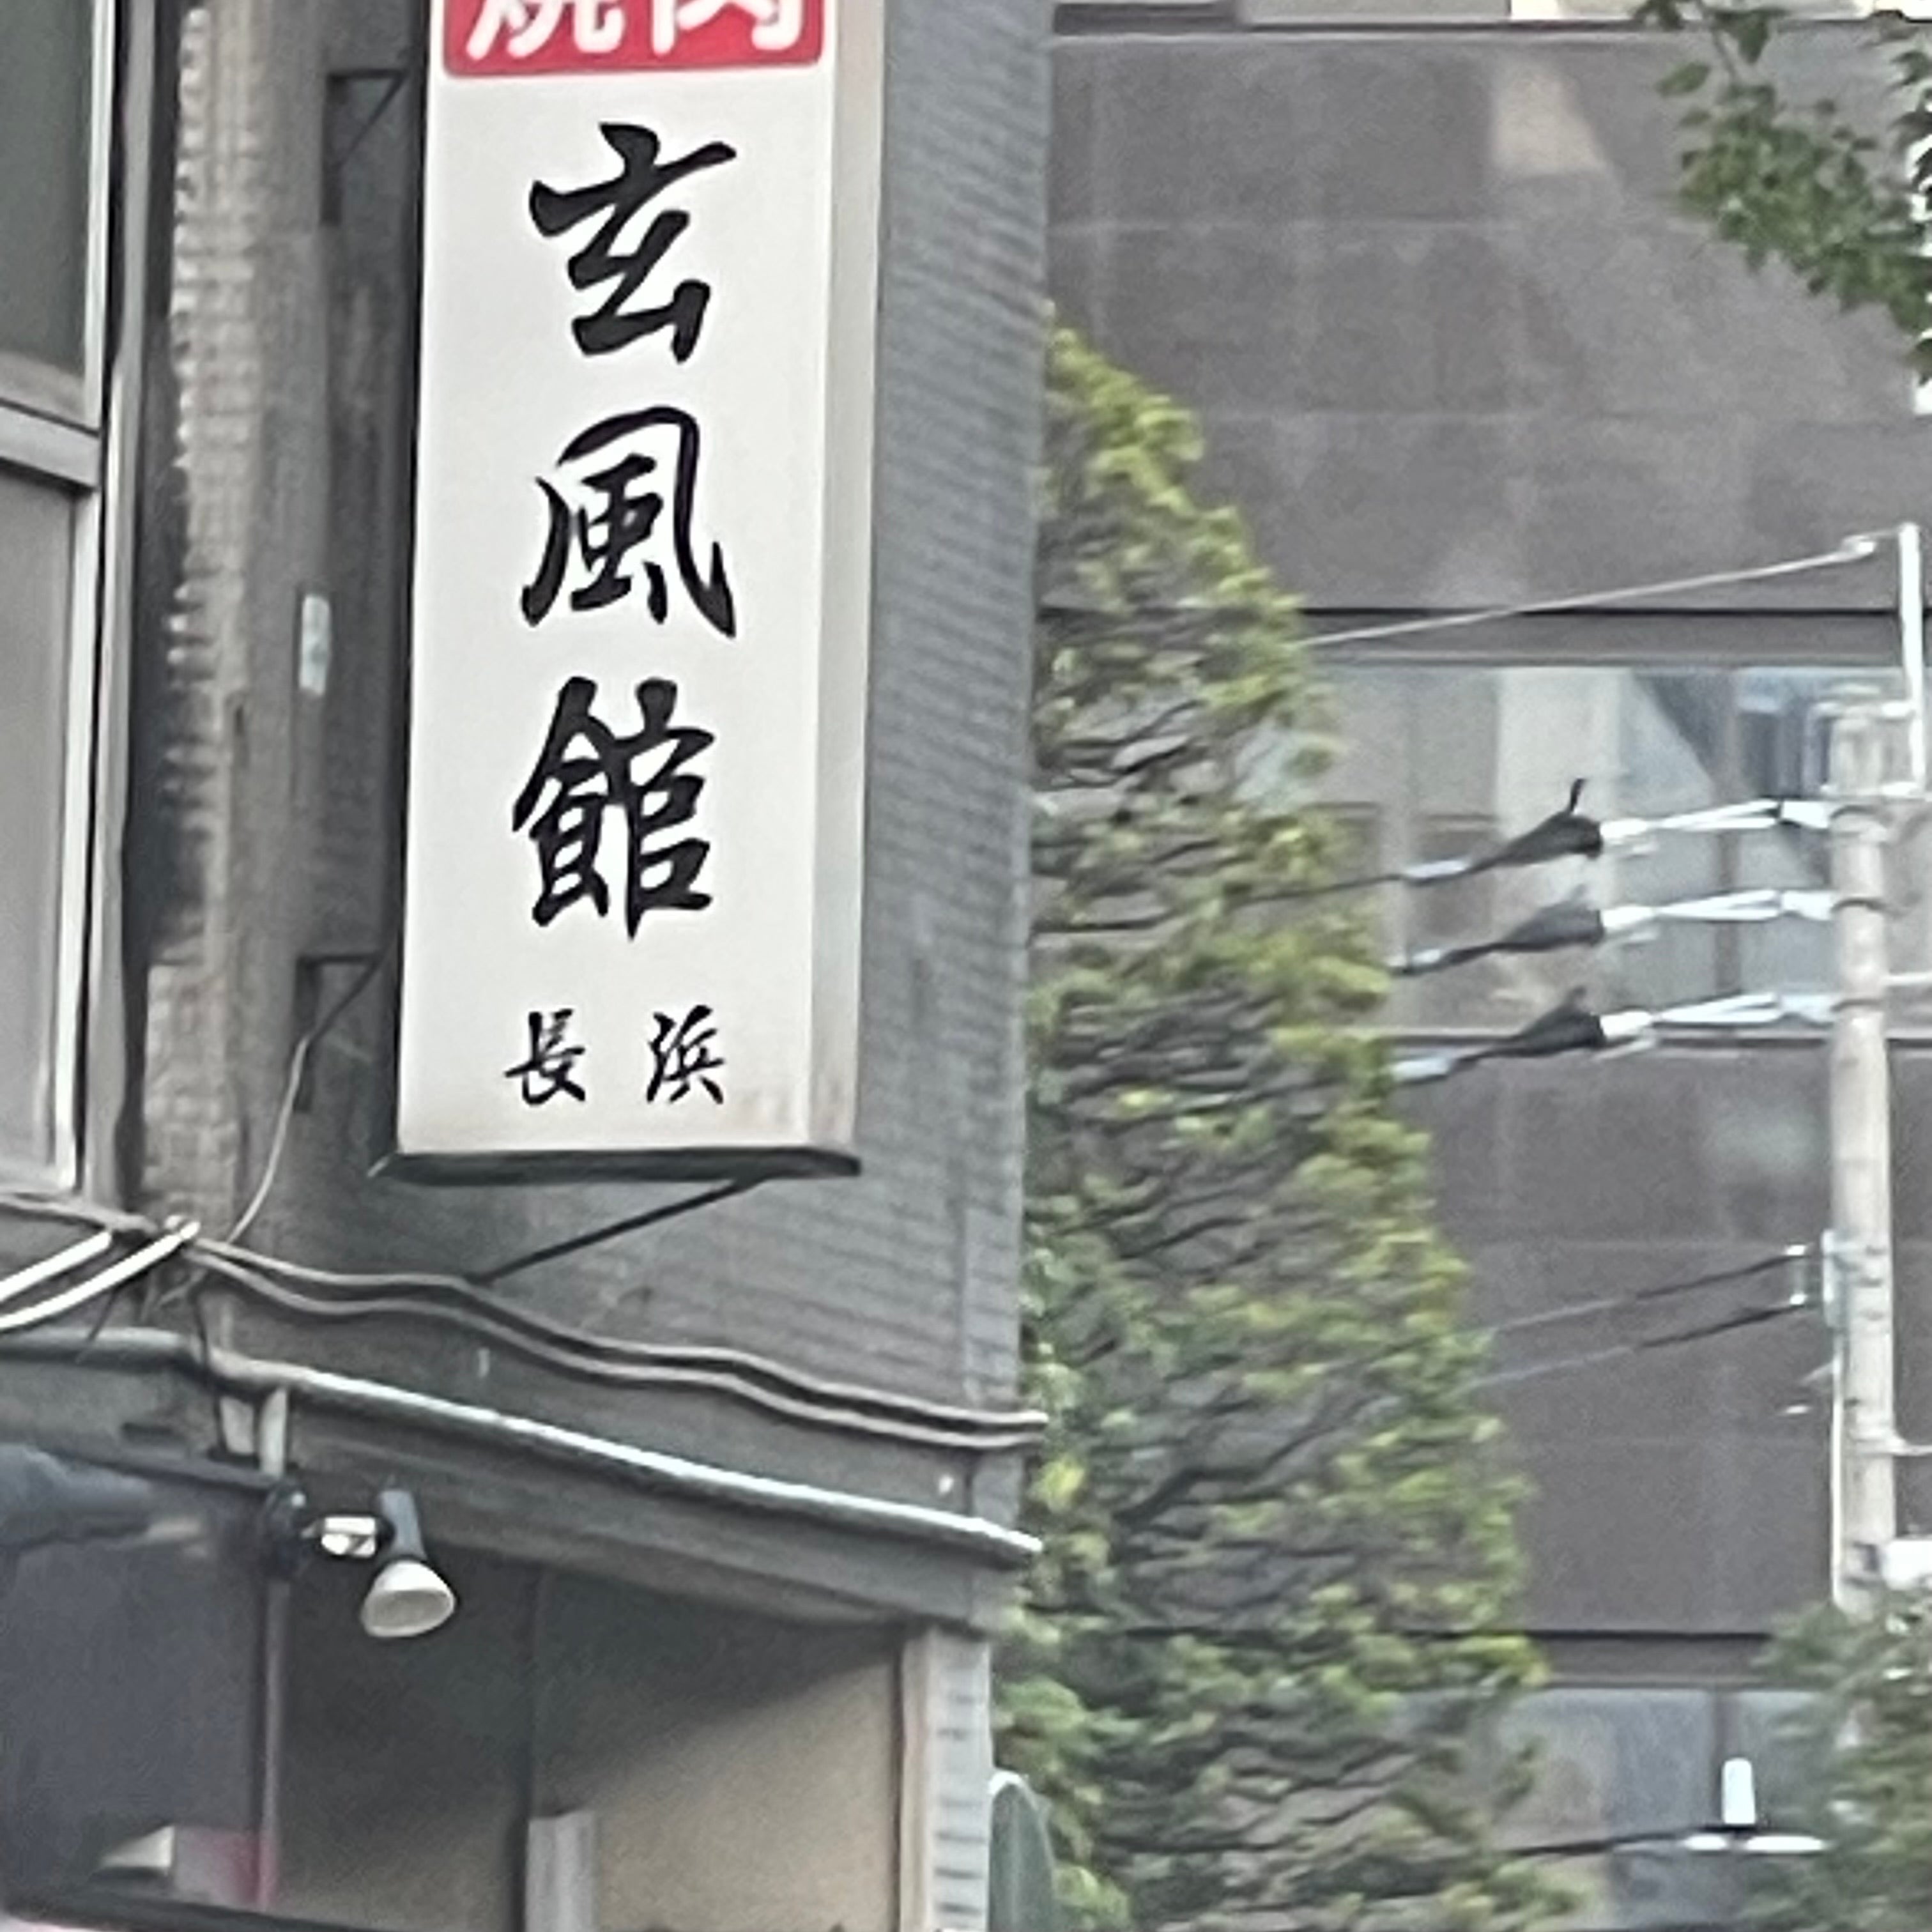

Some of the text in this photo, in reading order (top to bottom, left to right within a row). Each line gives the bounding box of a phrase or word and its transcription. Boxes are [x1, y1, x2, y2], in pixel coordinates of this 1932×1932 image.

[512, 121, 737, 939] 玄風館
[504, 1004, 724, 1105] 長浜
